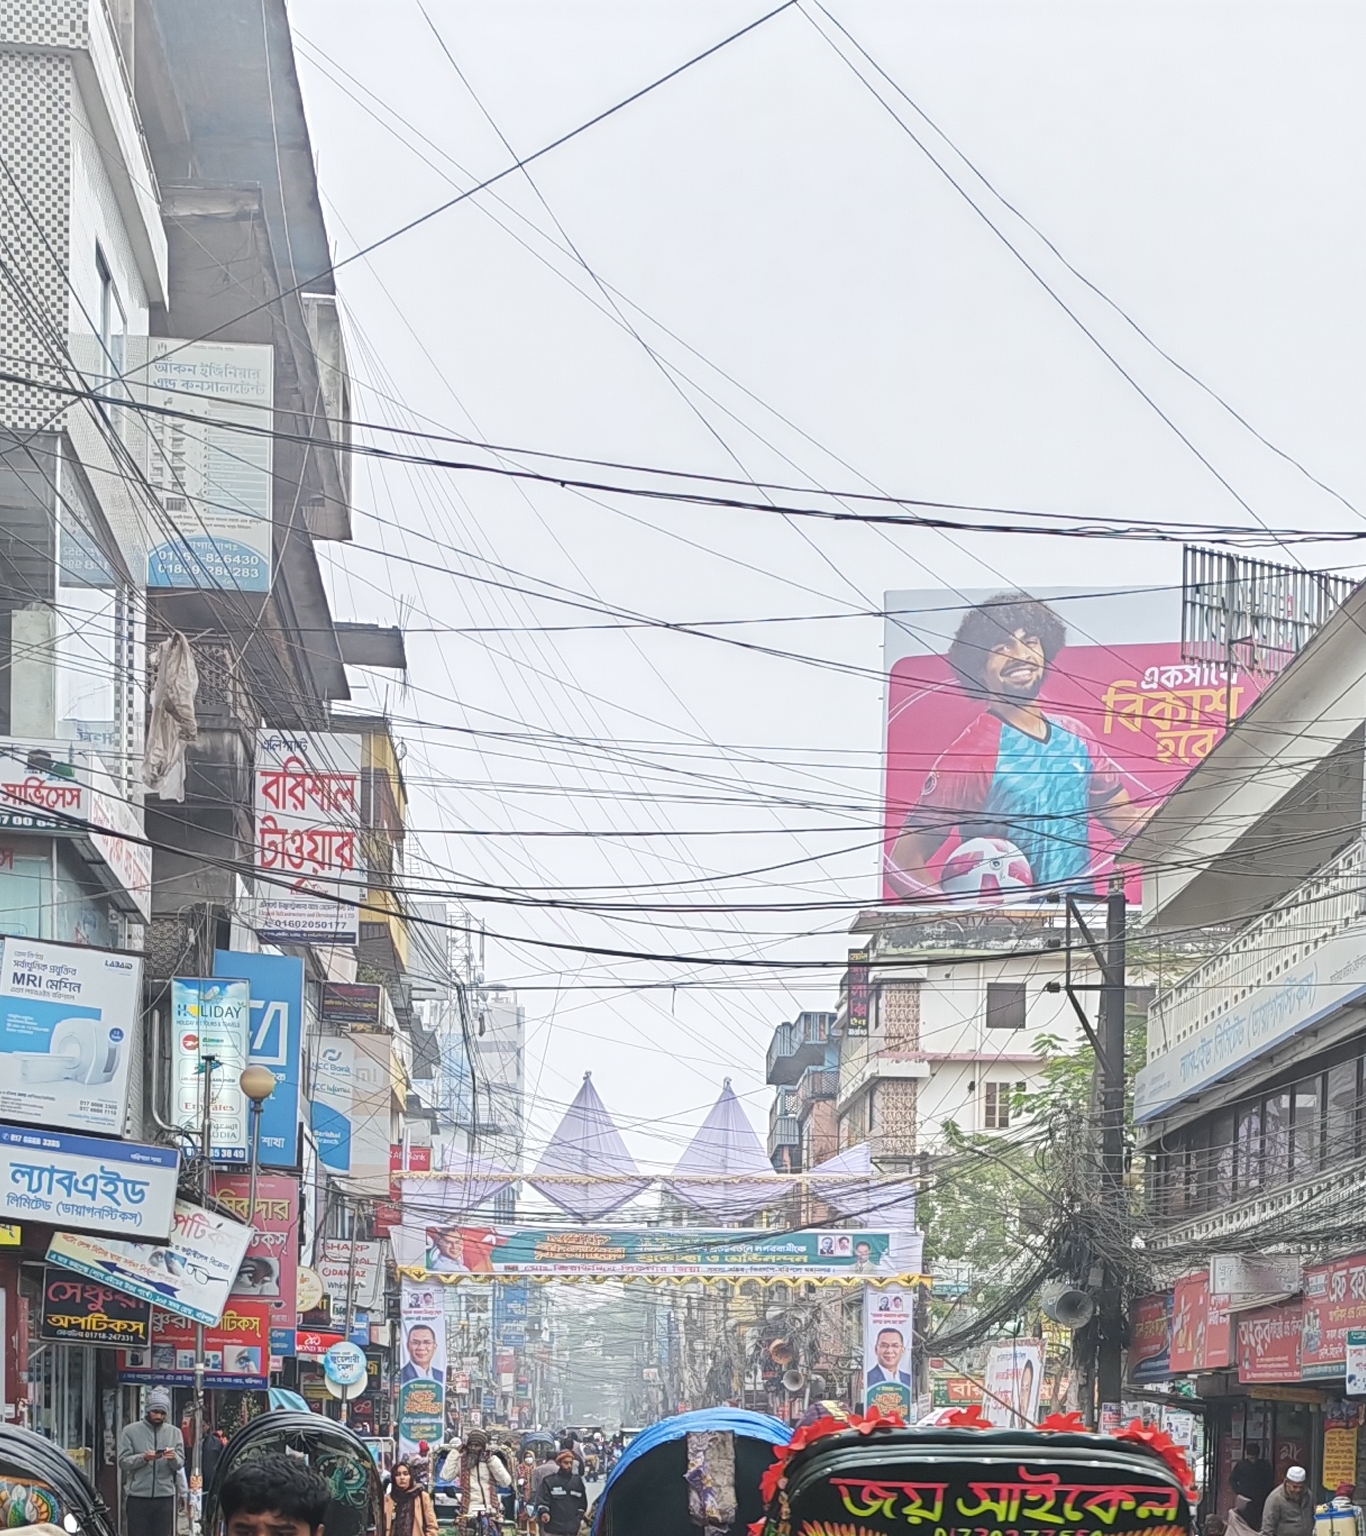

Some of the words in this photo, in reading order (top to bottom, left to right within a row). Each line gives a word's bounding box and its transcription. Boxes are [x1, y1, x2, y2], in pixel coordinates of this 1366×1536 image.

[1101, 680, 1244, 734] বিকাশ
[260, 756, 357, 812] বরিশাল
[260, 815, 356, 876] টাওয়ার
[12, 972, 42, 988] MRI
[46, 978, 81, 993] মেশিন
[210, 1131, 237, 1139] UDIA
[261, 1136, 285, 1148] শাখা
[222, 1150, 233, 1158] 38
[233, 1151, 245, 1159] 49
[9, 1162, 150, 1206] ল্যাবএইড
[6, 1192, 52, 1212] লিমিটেড
[47, 1313, 145, 1340] অপটিকস্
[830, 1477, 949, 1524] জয়
[956, 1465, 1180, 1525] সাইকেল
